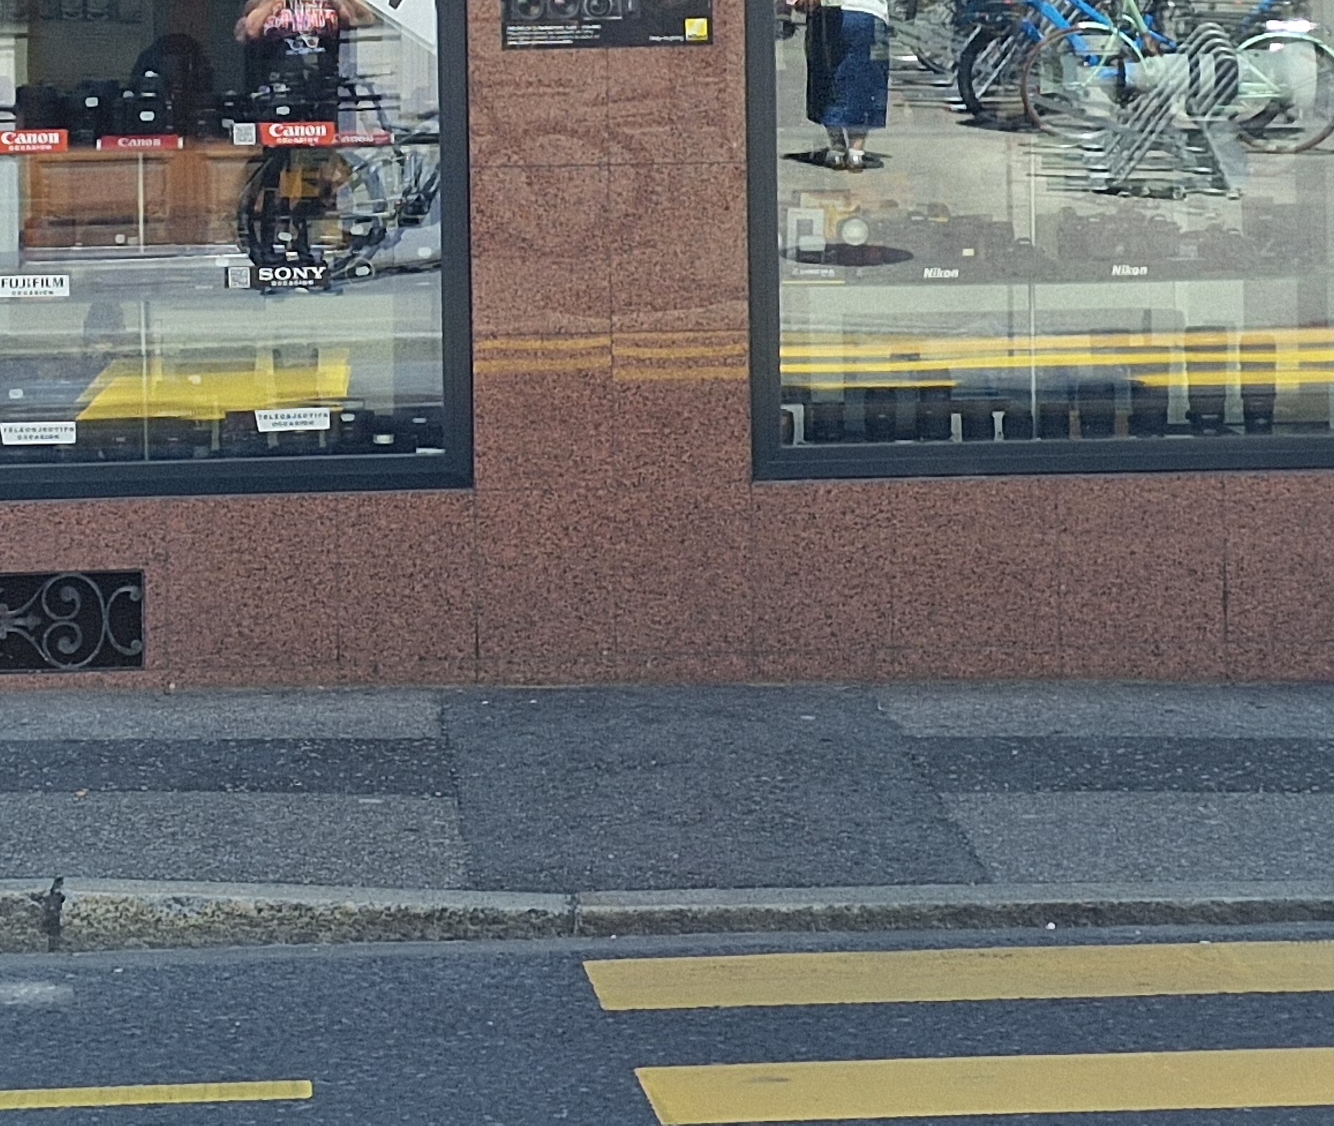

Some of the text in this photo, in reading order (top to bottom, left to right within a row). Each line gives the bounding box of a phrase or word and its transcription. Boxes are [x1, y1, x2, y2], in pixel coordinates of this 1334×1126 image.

[269, 123, 327, 137] Canon
[1, 131, 60, 145] Canon
[117, 137, 161, 148] Canon
[258, 266, 327, 281] SONY
[923, 267, 959, 278] Nikon
[1112, 265, 1148, 275] Nikon
[1, 277, 64, 288] FUJIFILM
